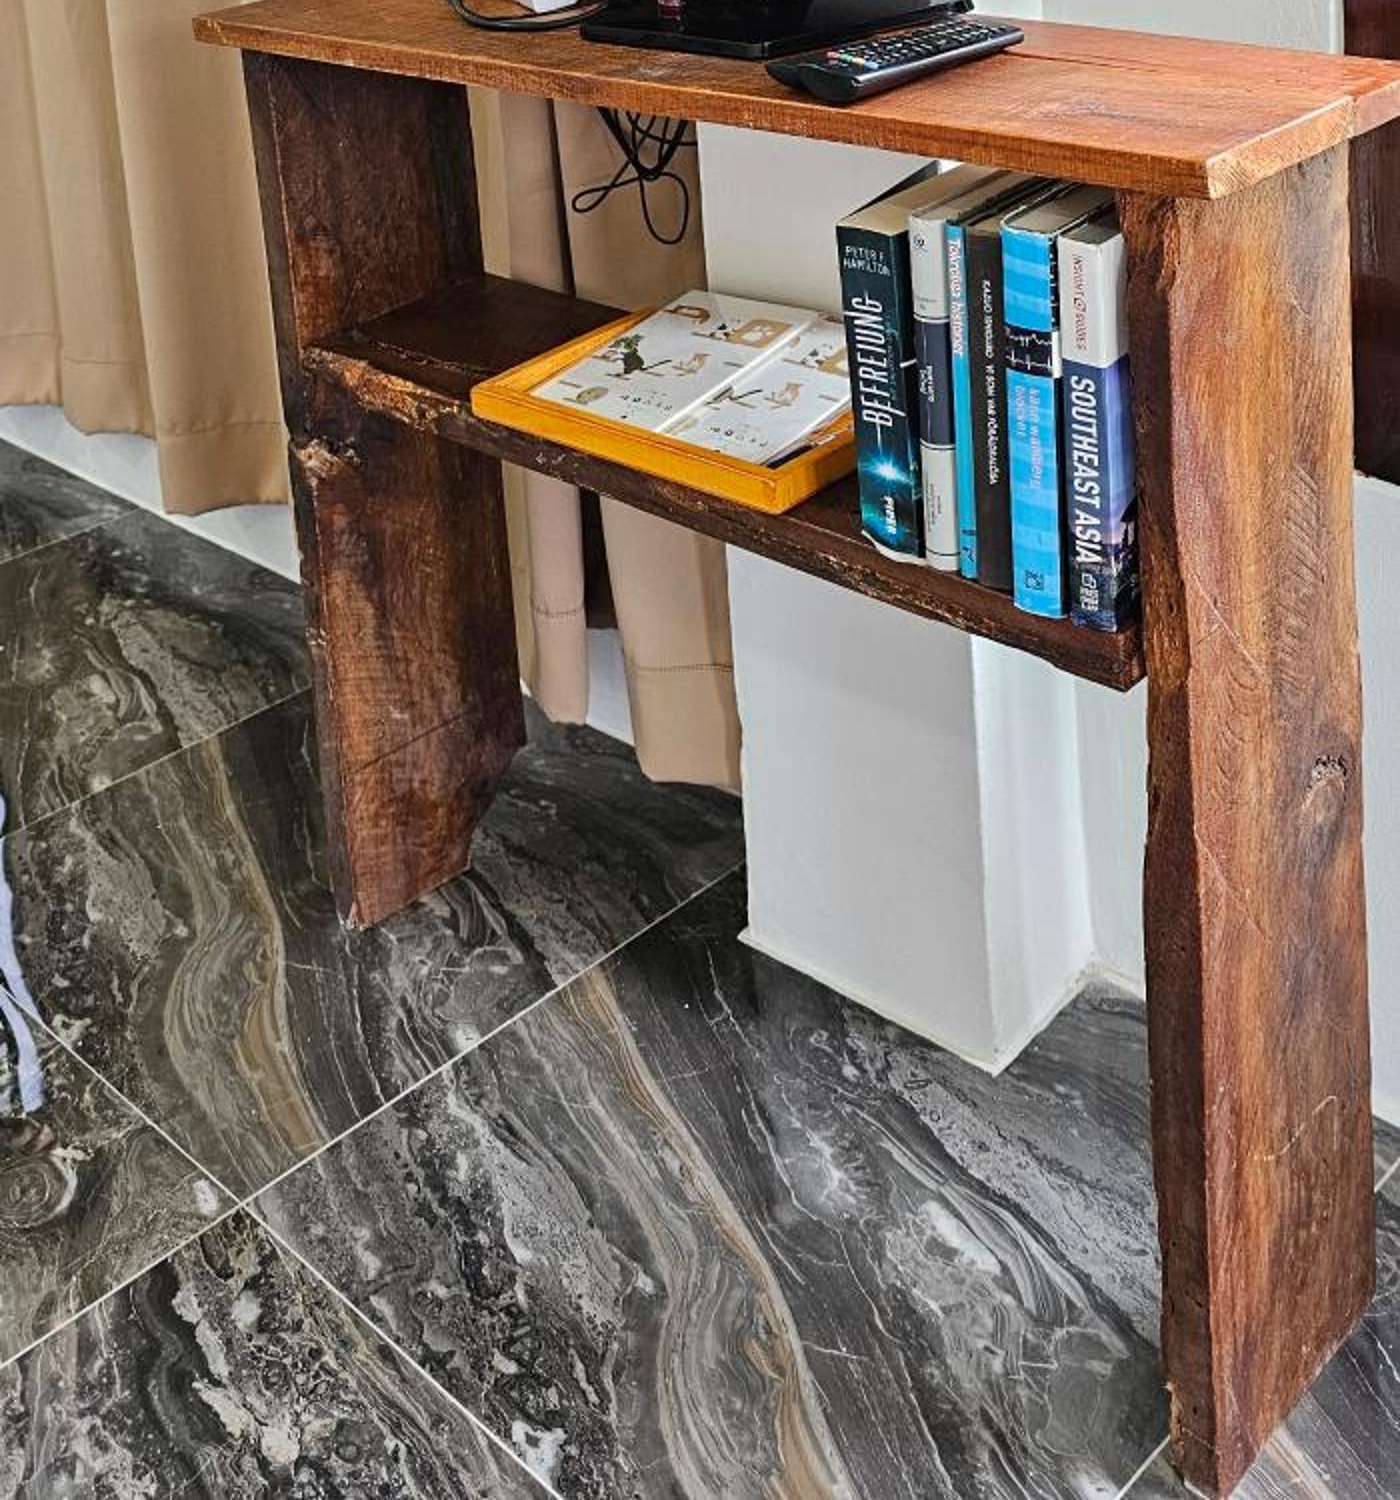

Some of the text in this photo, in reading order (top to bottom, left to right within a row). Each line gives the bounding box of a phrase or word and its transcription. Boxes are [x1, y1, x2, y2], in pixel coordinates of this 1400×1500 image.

[843, 257, 891, 277] HAMILTON
[845, 245, 878, 261] PETER
[1075, 254, 1088, 350] INSIGHT GUIDES
[843, 291, 906, 428] BEFREIUNG
[1070, 375, 1100, 509] SOUTHEAST
[883, 495, 897, 535] PIPER
[1074, 509, 1103, 564] ASIA
